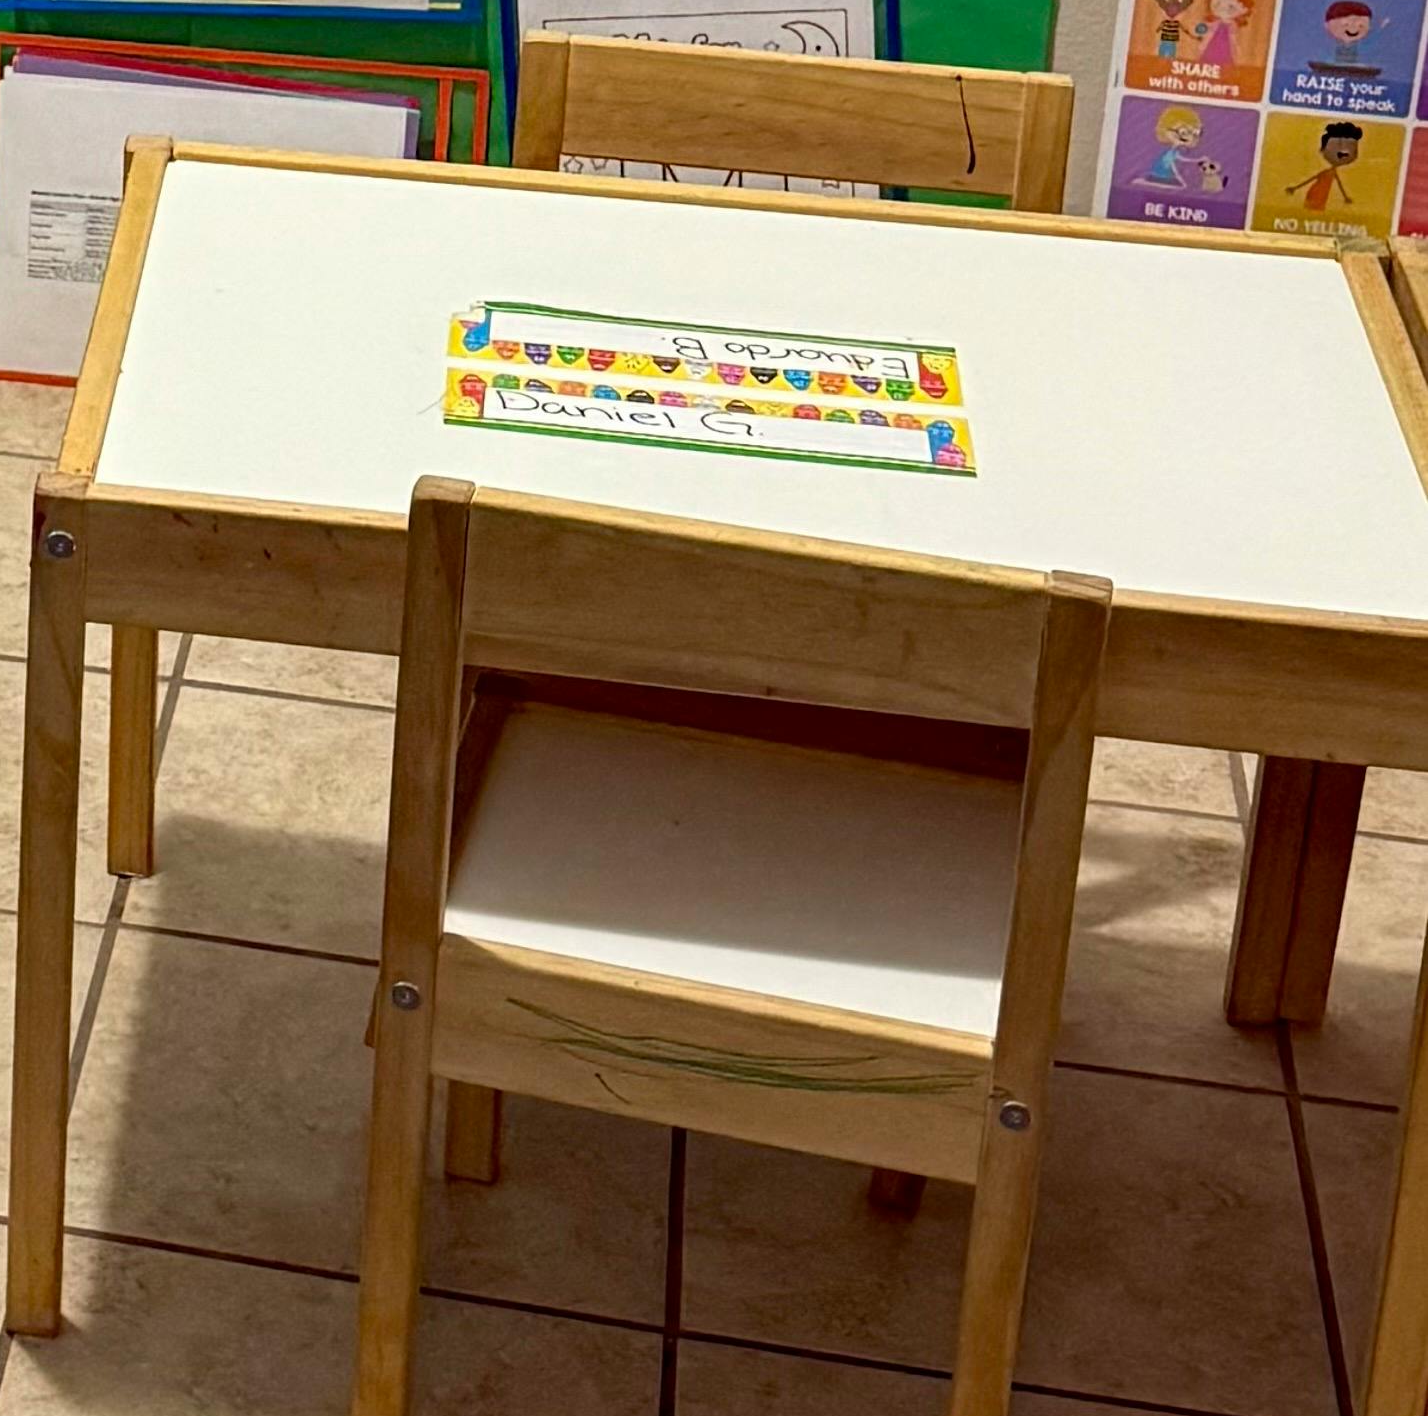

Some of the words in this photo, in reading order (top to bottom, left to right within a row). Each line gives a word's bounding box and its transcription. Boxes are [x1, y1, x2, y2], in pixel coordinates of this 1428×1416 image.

[1170, 60, 1222, 79] SHARE
[1148, 75, 1185, 91] with
[1187, 80, 1241, 97] others
[1296, 73, 1345, 93] RAISE
[1349, 81, 1388, 99] your
[1281, 88, 1324, 105] hand
[1326, 93, 1343, 107] to
[1347, 95, 1397, 114] speak
[1144, 202, 1166, 218] BE
[1167, 206, 1209, 223] KIND
[1273, 217, 1299, 232] NO
[724, 340, 910, 381] Eduardo
[498, 388, 678, 432] Daniel
